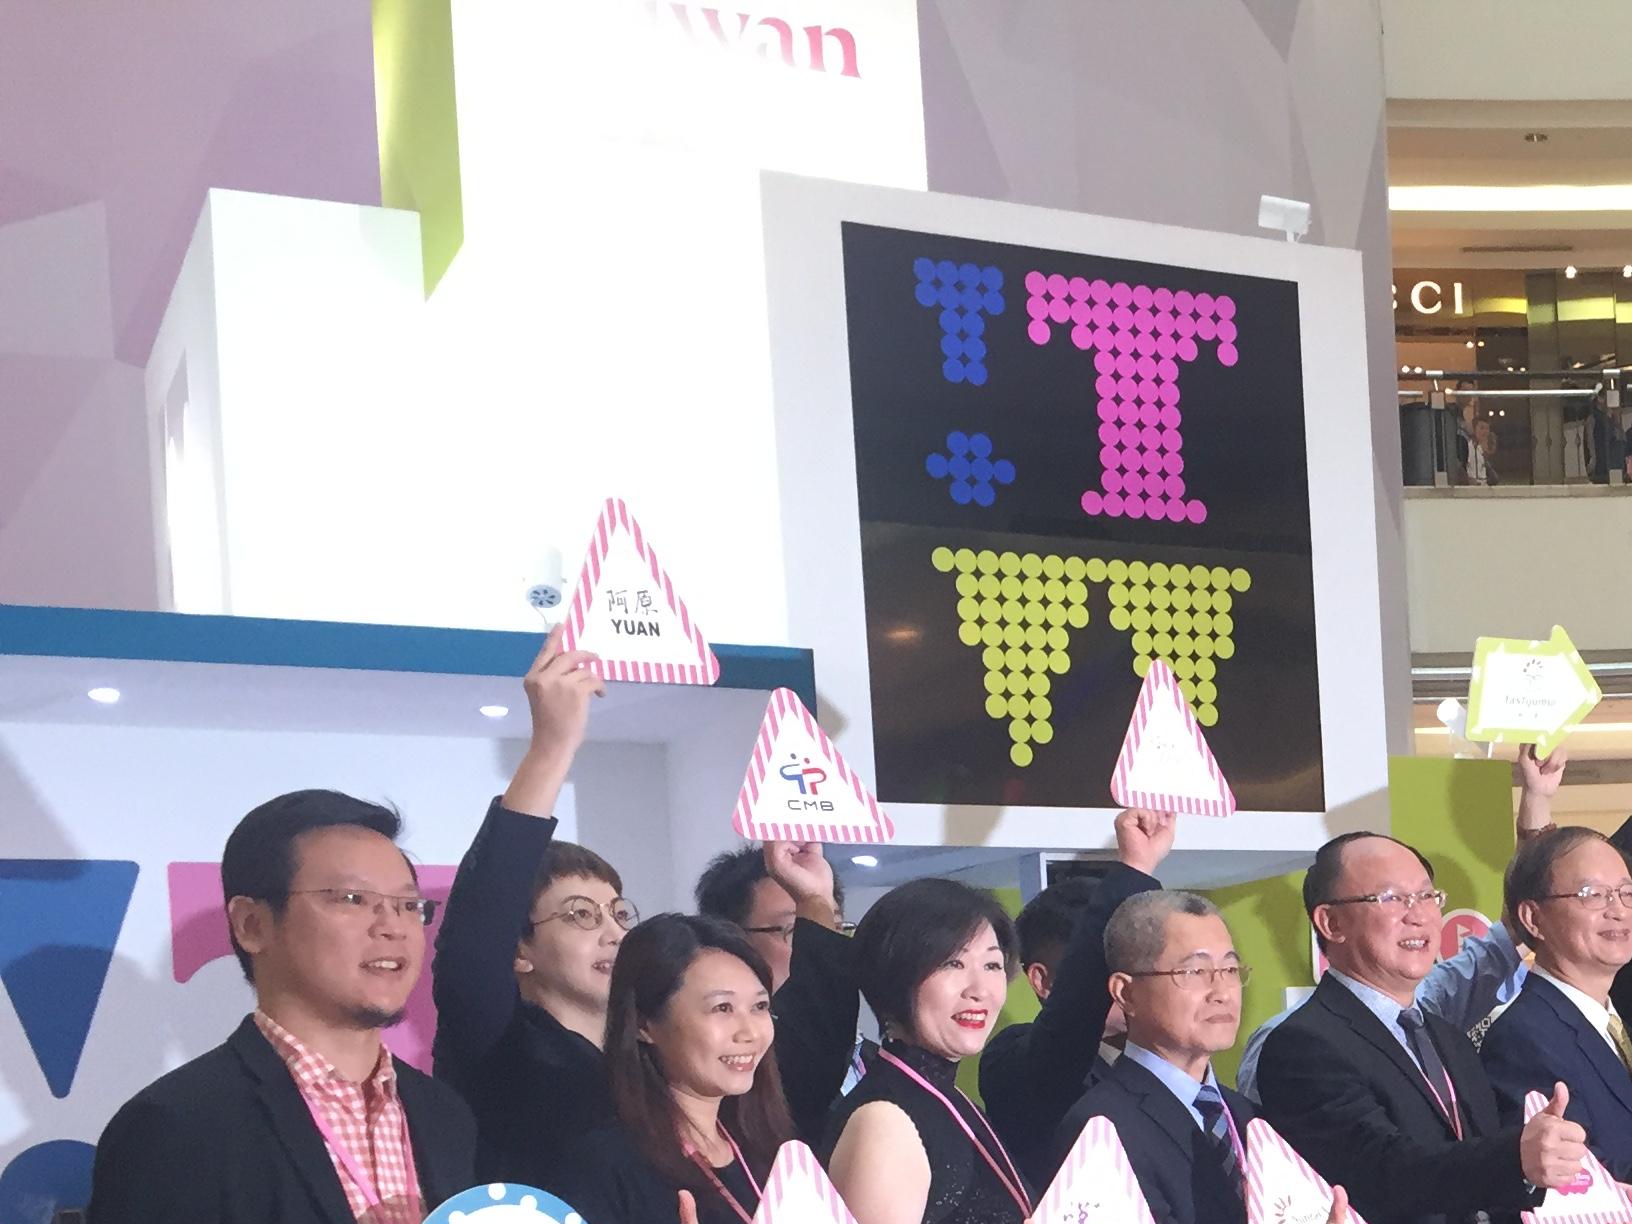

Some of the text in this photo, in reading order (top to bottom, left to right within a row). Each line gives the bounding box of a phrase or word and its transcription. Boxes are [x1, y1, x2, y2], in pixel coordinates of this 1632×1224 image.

[1391, 280, 1464, 315] CI
[604, 588, 660, 617] 阿原
[610, 618, 662, 638] YUAN
[786, 798, 835, 813] CMB
